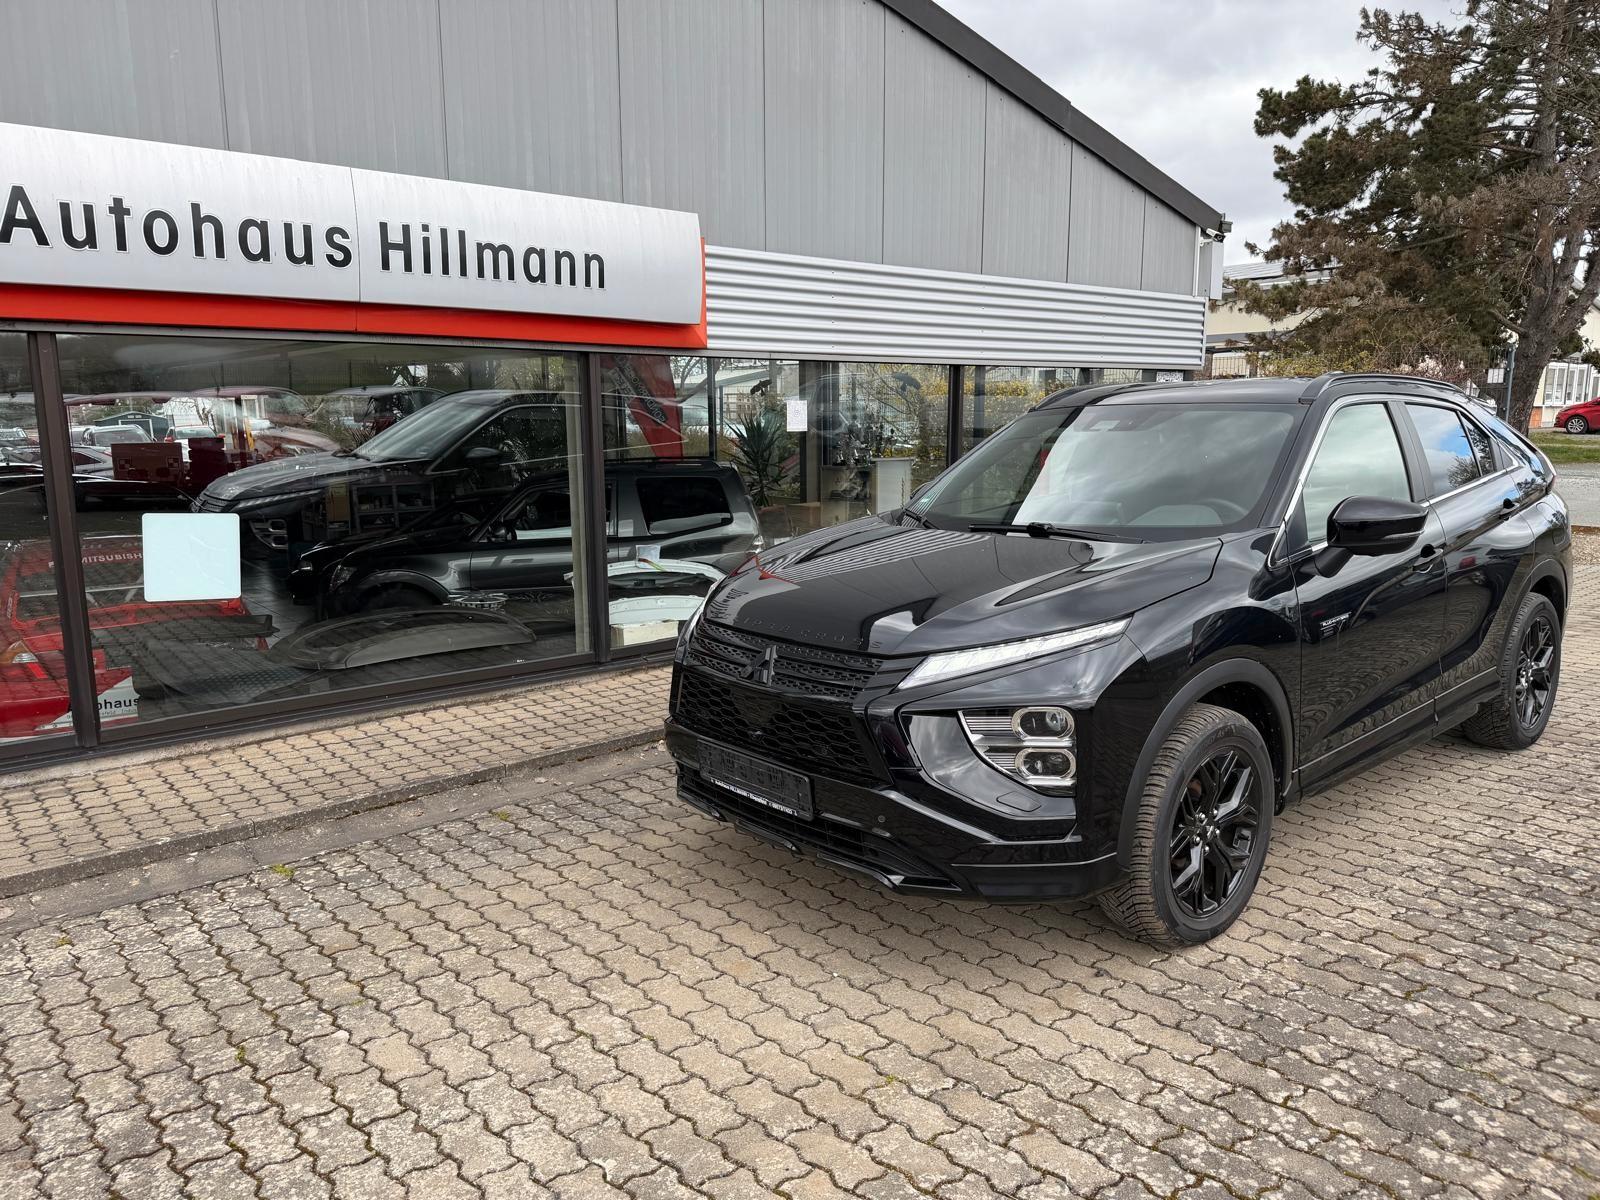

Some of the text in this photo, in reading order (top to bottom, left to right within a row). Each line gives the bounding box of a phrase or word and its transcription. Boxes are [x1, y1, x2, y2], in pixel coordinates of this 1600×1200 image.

[0, 184, 607, 290] Autohaus Hillmann
[82, 553, 142, 564] MITSUBISH
